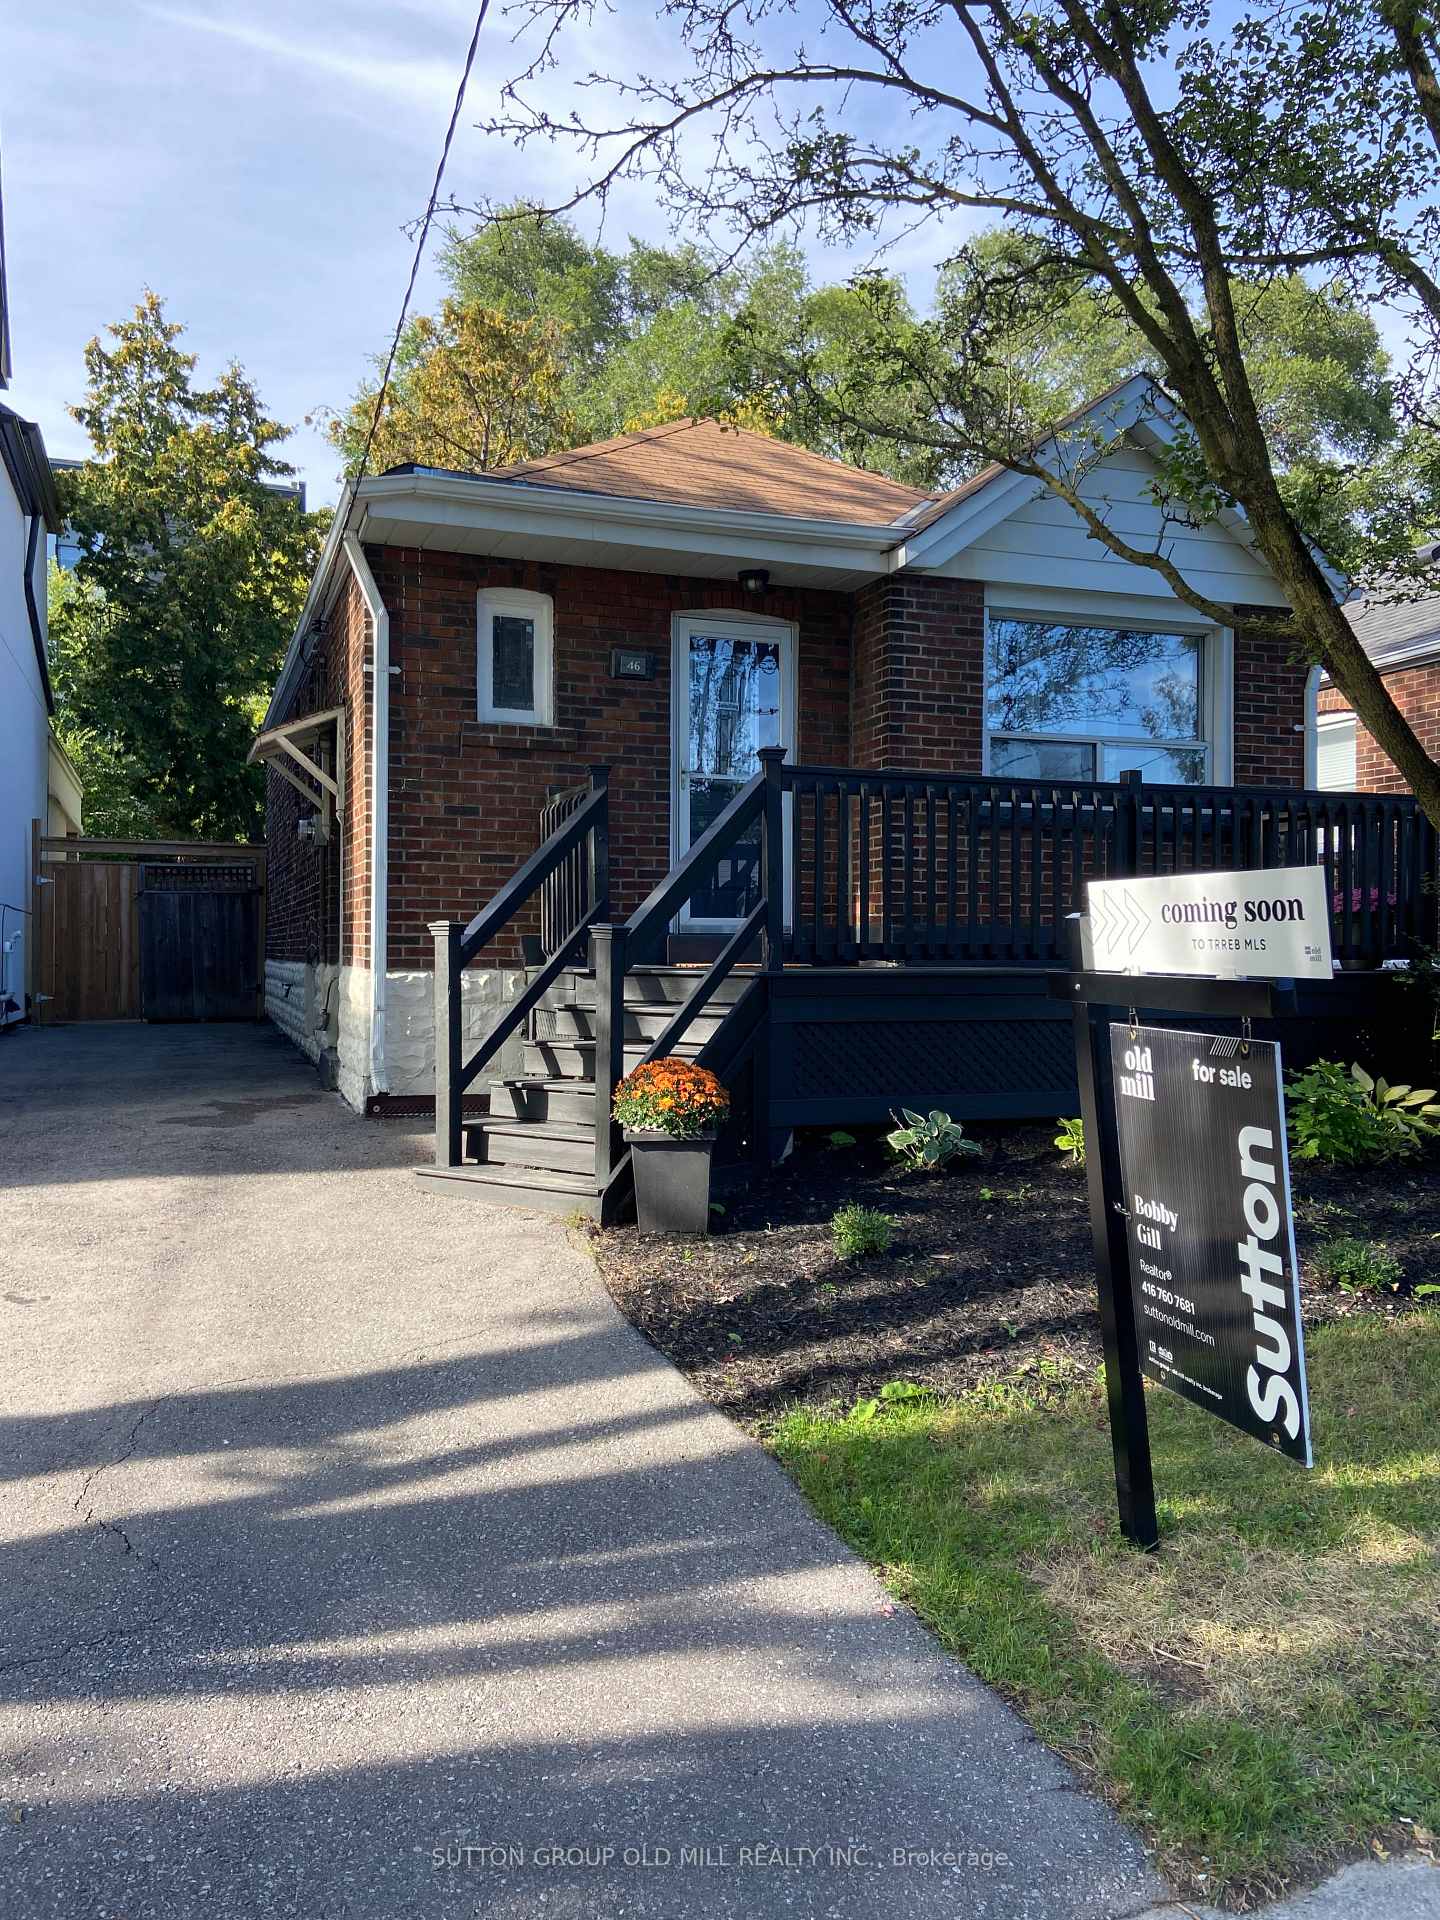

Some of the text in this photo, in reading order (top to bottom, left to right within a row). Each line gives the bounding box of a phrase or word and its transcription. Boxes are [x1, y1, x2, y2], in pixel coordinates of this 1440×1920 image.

[626, 660, 641, 672] 46
[1161, 897, 1305, 929] coming soon
[1191, 938, 1266, 950] TO TRREB MLS
[1124, 1046, 1153, 1073] old
[1192, 1058, 1252, 1089] for sale
[1119, 1074, 1155, 1101] mill
[1134, 1194, 1178, 1232] Bobby
[1136, 1224, 1162, 1250] Gill
[1141, 1281, 1196, 1315] 416 760 7681
[1238, 1126, 1301, 1440] Sutton
[1143, 1304, 1215, 1347] suttonoldmill.com
